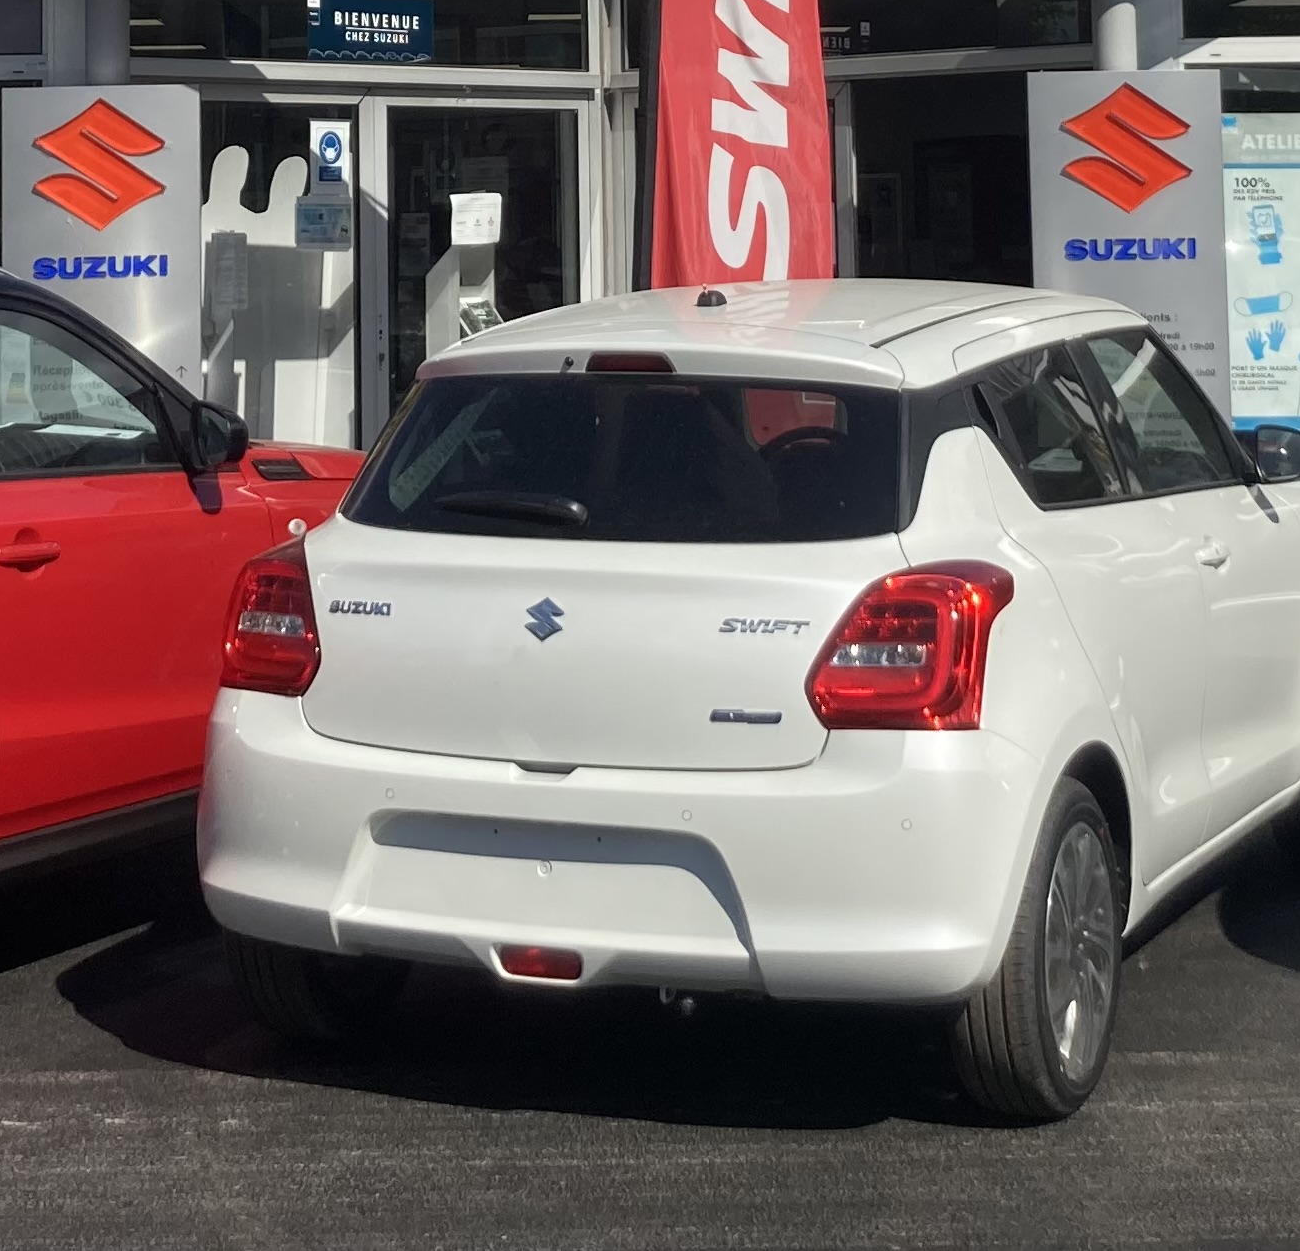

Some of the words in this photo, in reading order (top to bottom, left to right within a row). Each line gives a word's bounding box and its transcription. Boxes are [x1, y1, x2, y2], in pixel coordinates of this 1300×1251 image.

[334, 10, 420, 30] BIENVENUE
[345, 31, 370, 42] CHEZ
[373, 32, 409, 44] SUZUKI
[1233, 177, 1271, 188] 100%
[1064, 237, 1197, 262] SUZUKI
[32, 254, 168, 280] SUZUKI
[329, 600, 392, 617] SUZUKI
[718, 617, 811, 635] SWIFT
